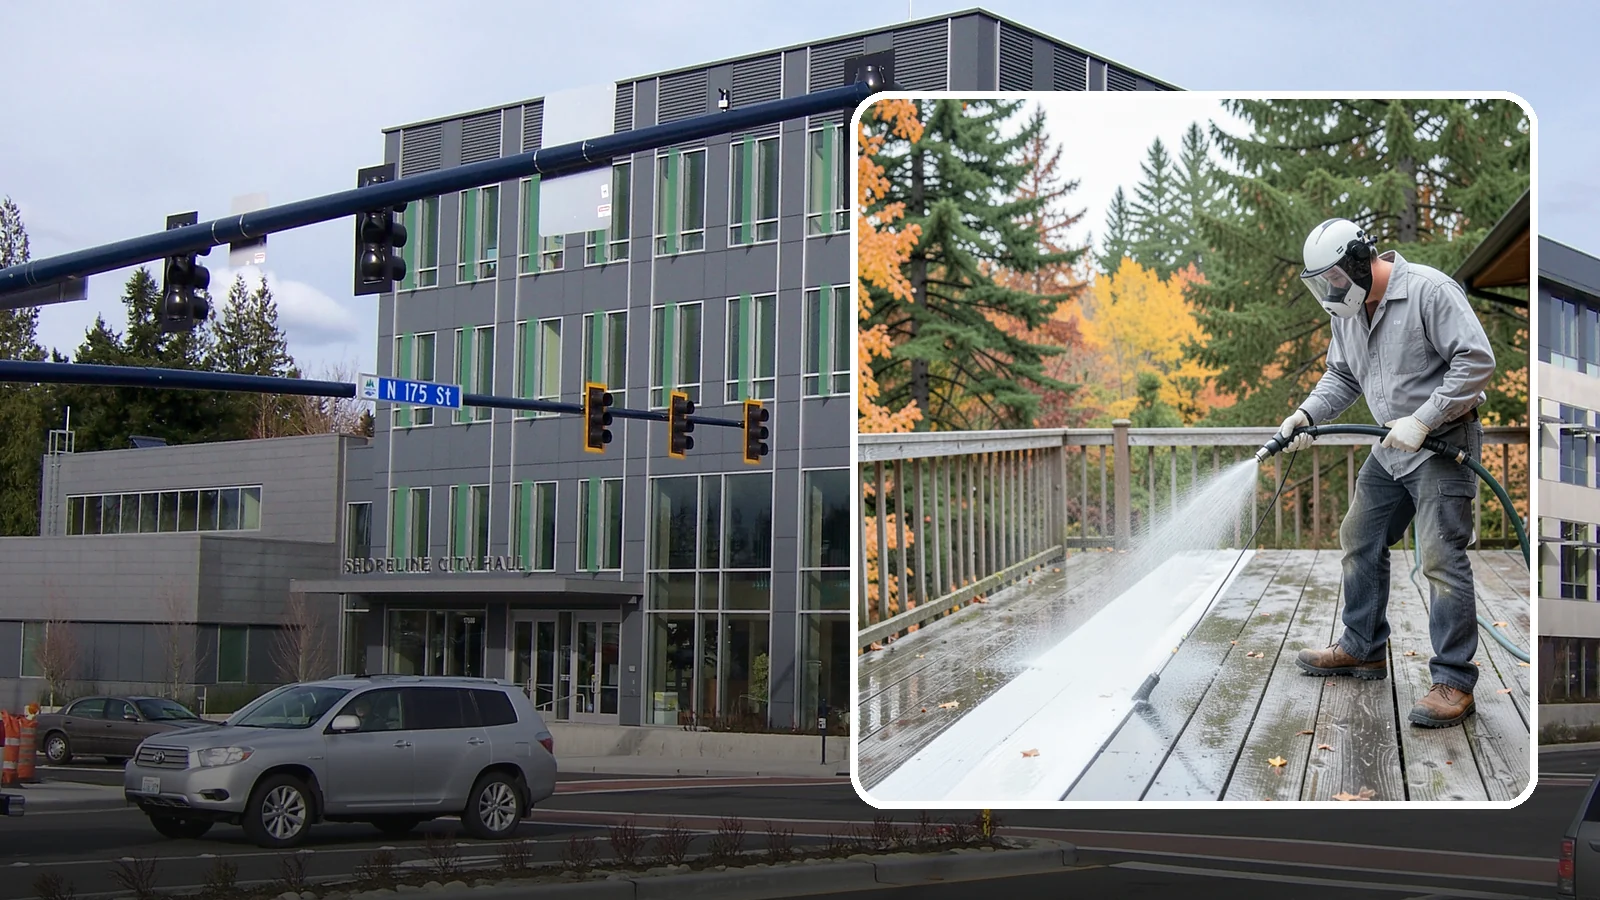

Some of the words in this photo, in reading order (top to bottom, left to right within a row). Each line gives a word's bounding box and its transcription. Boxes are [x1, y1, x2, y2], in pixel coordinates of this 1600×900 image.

[387, 380, 396, 400] N
[405, 382, 427, 403] 175
[436, 386, 451, 406] St
[343, 558, 431, 574] SHORELINE
[438, 557, 474, 572] CITY
[484, 556, 525, 571] HALL
